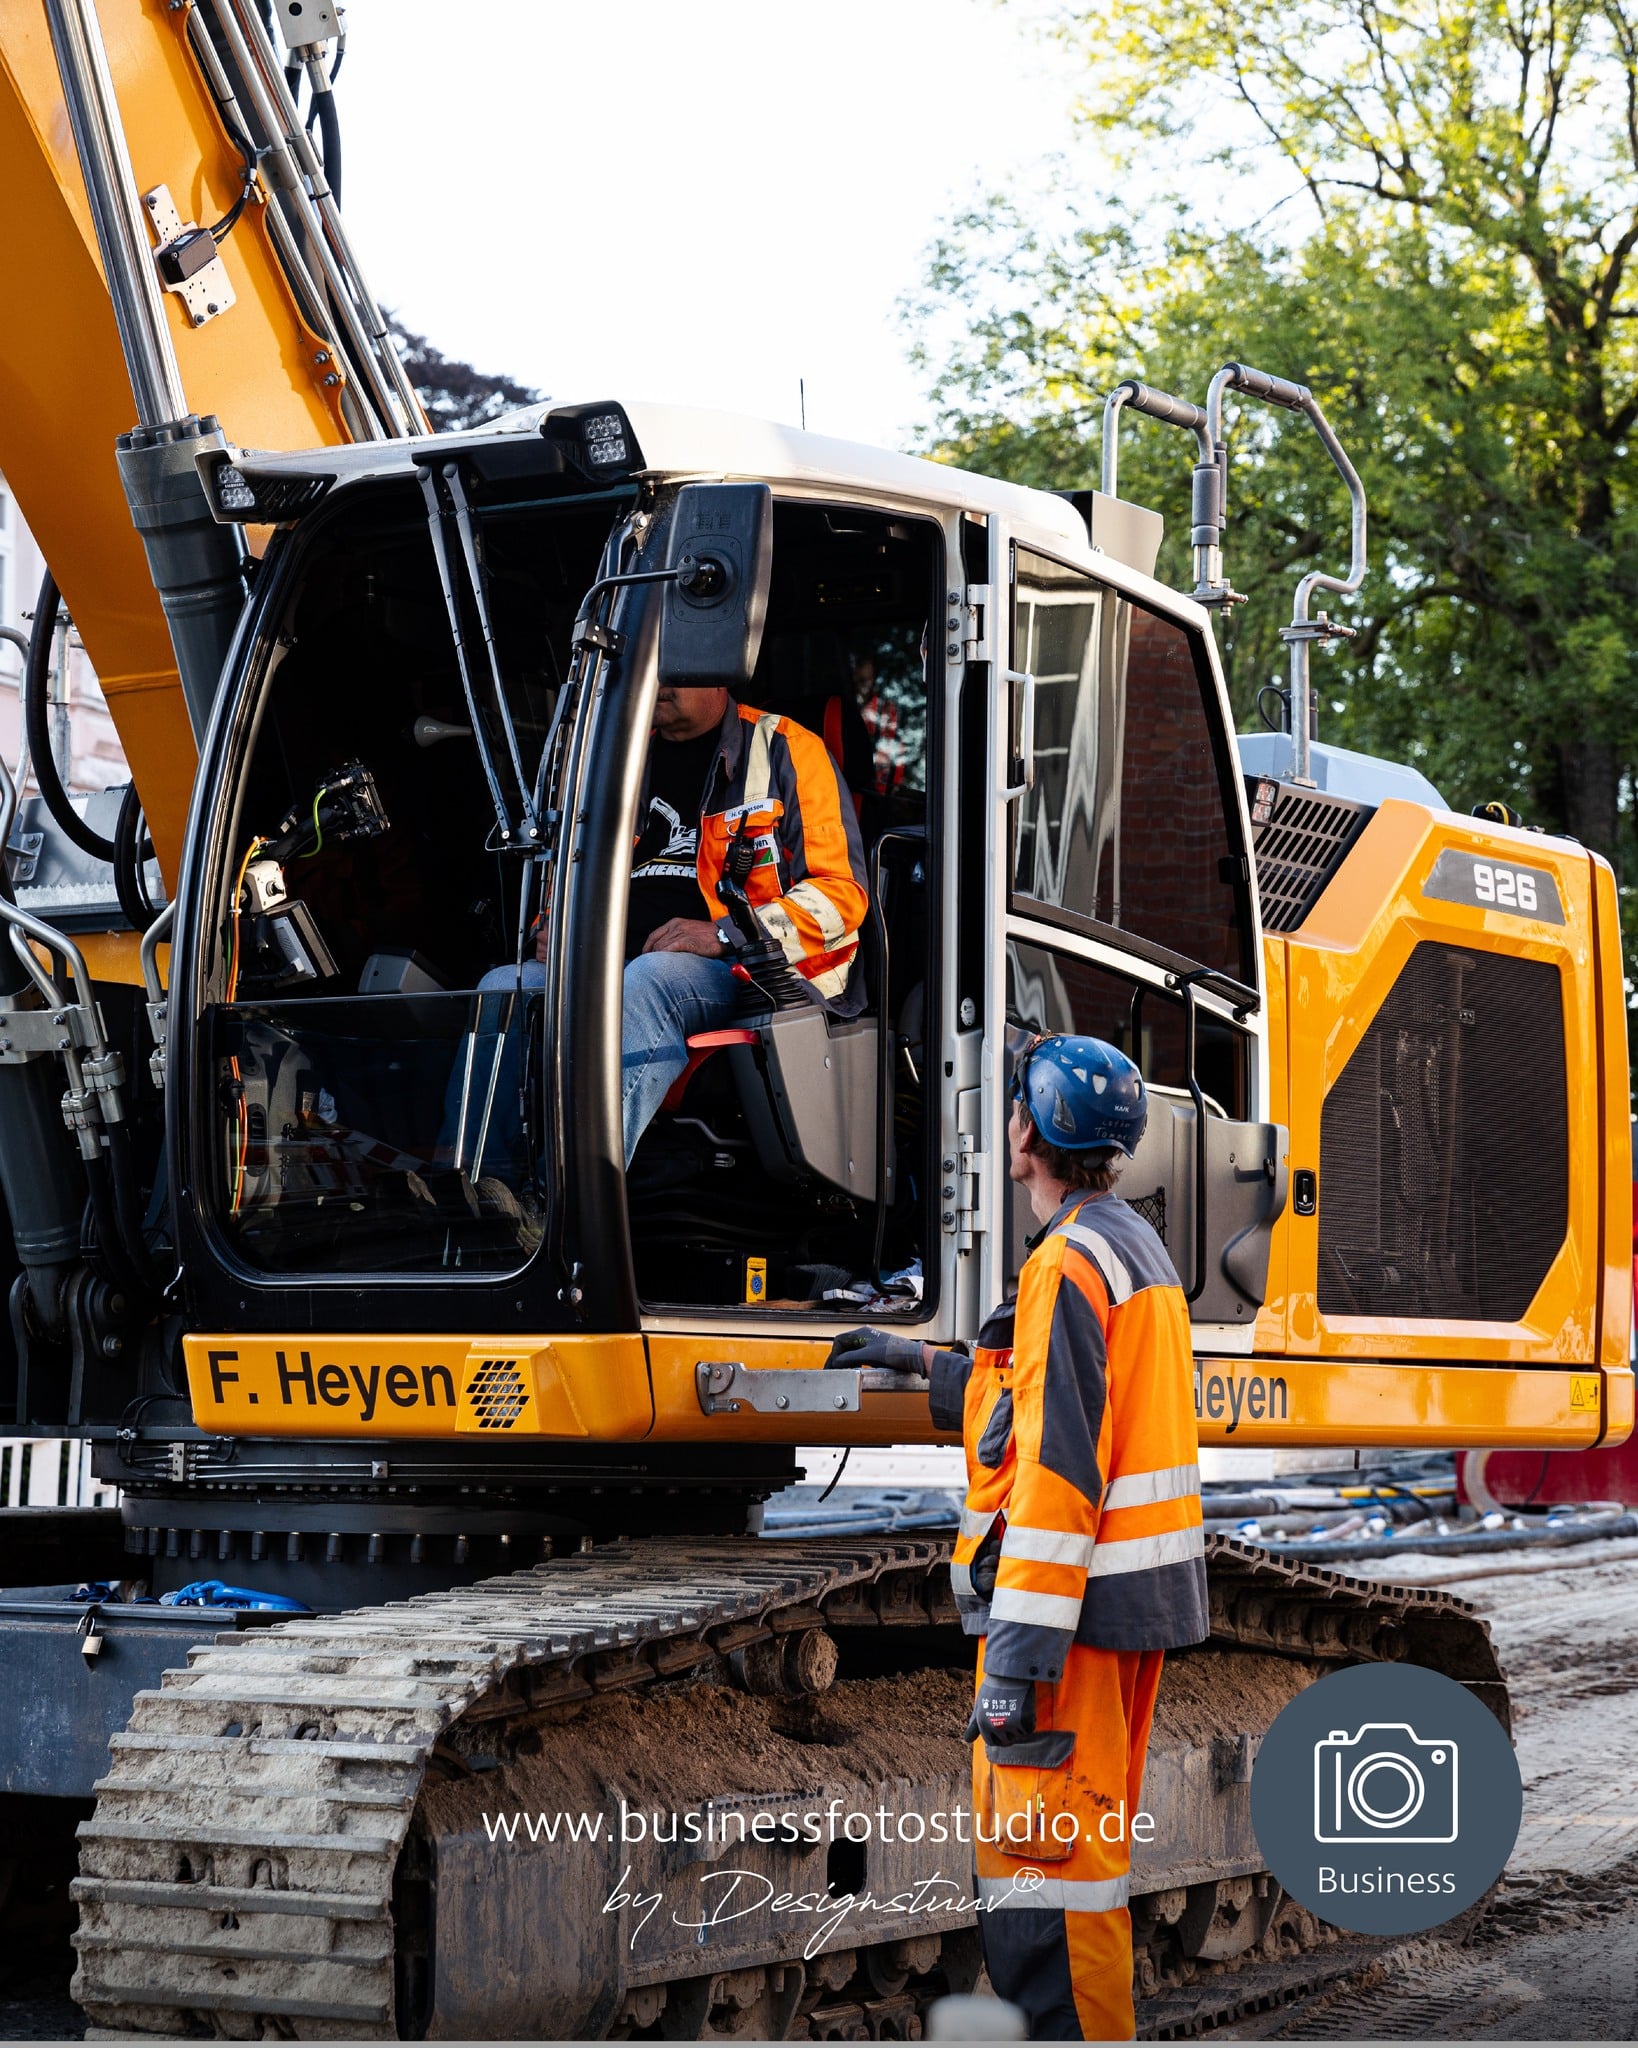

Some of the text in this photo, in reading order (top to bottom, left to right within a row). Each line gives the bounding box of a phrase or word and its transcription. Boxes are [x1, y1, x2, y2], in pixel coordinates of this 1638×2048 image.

[1473, 863, 1538, 912] 926
[208, 1350, 457, 1422] F. Heyen
